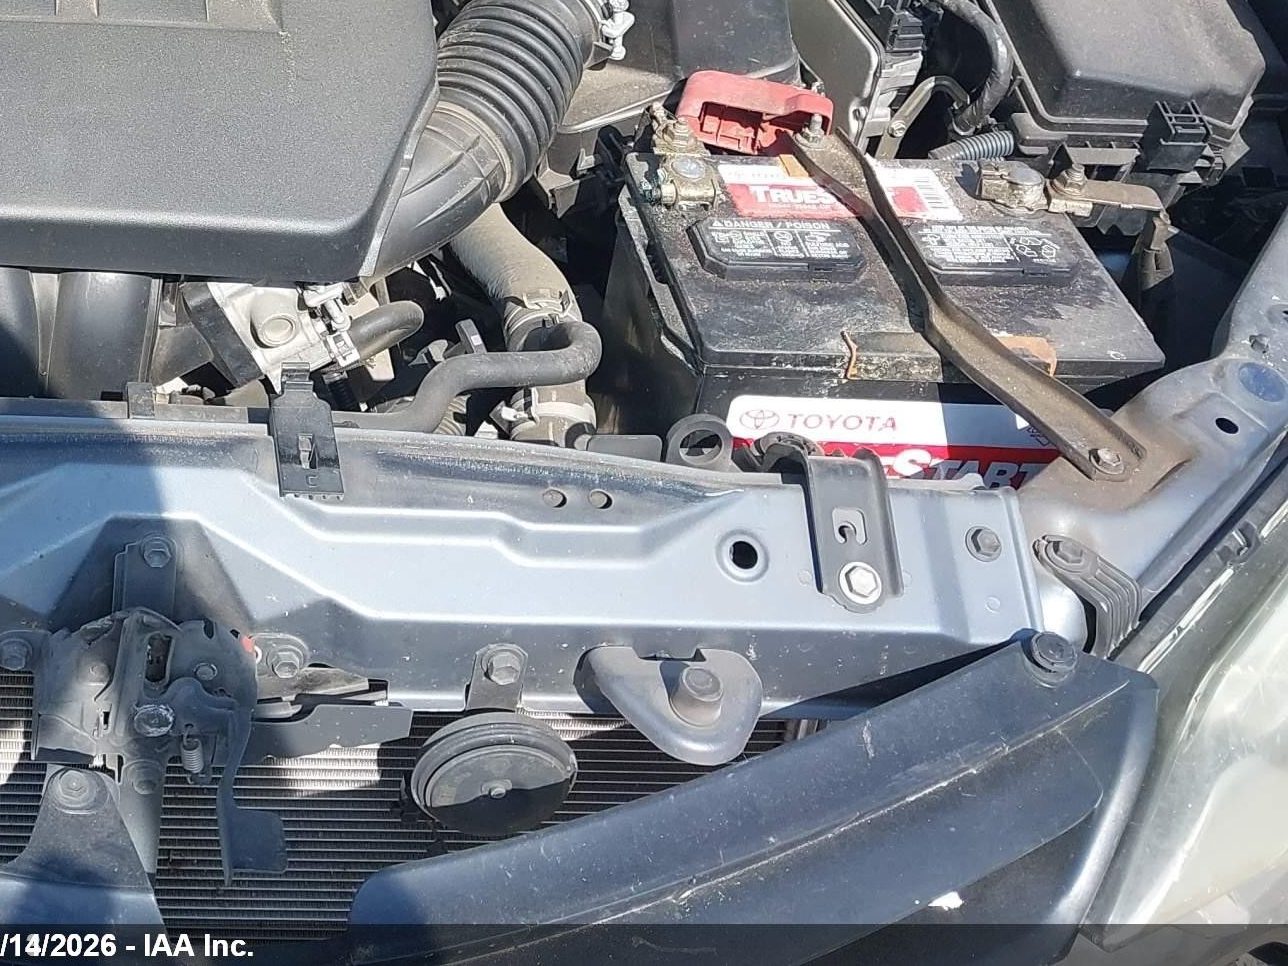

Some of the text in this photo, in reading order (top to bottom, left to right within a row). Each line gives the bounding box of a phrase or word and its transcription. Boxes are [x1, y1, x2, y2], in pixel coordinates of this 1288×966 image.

[724, 220, 772, 229] DANGER
[786, 221, 830, 229] POISON
[787, 413, 897, 432] TOYOTA
